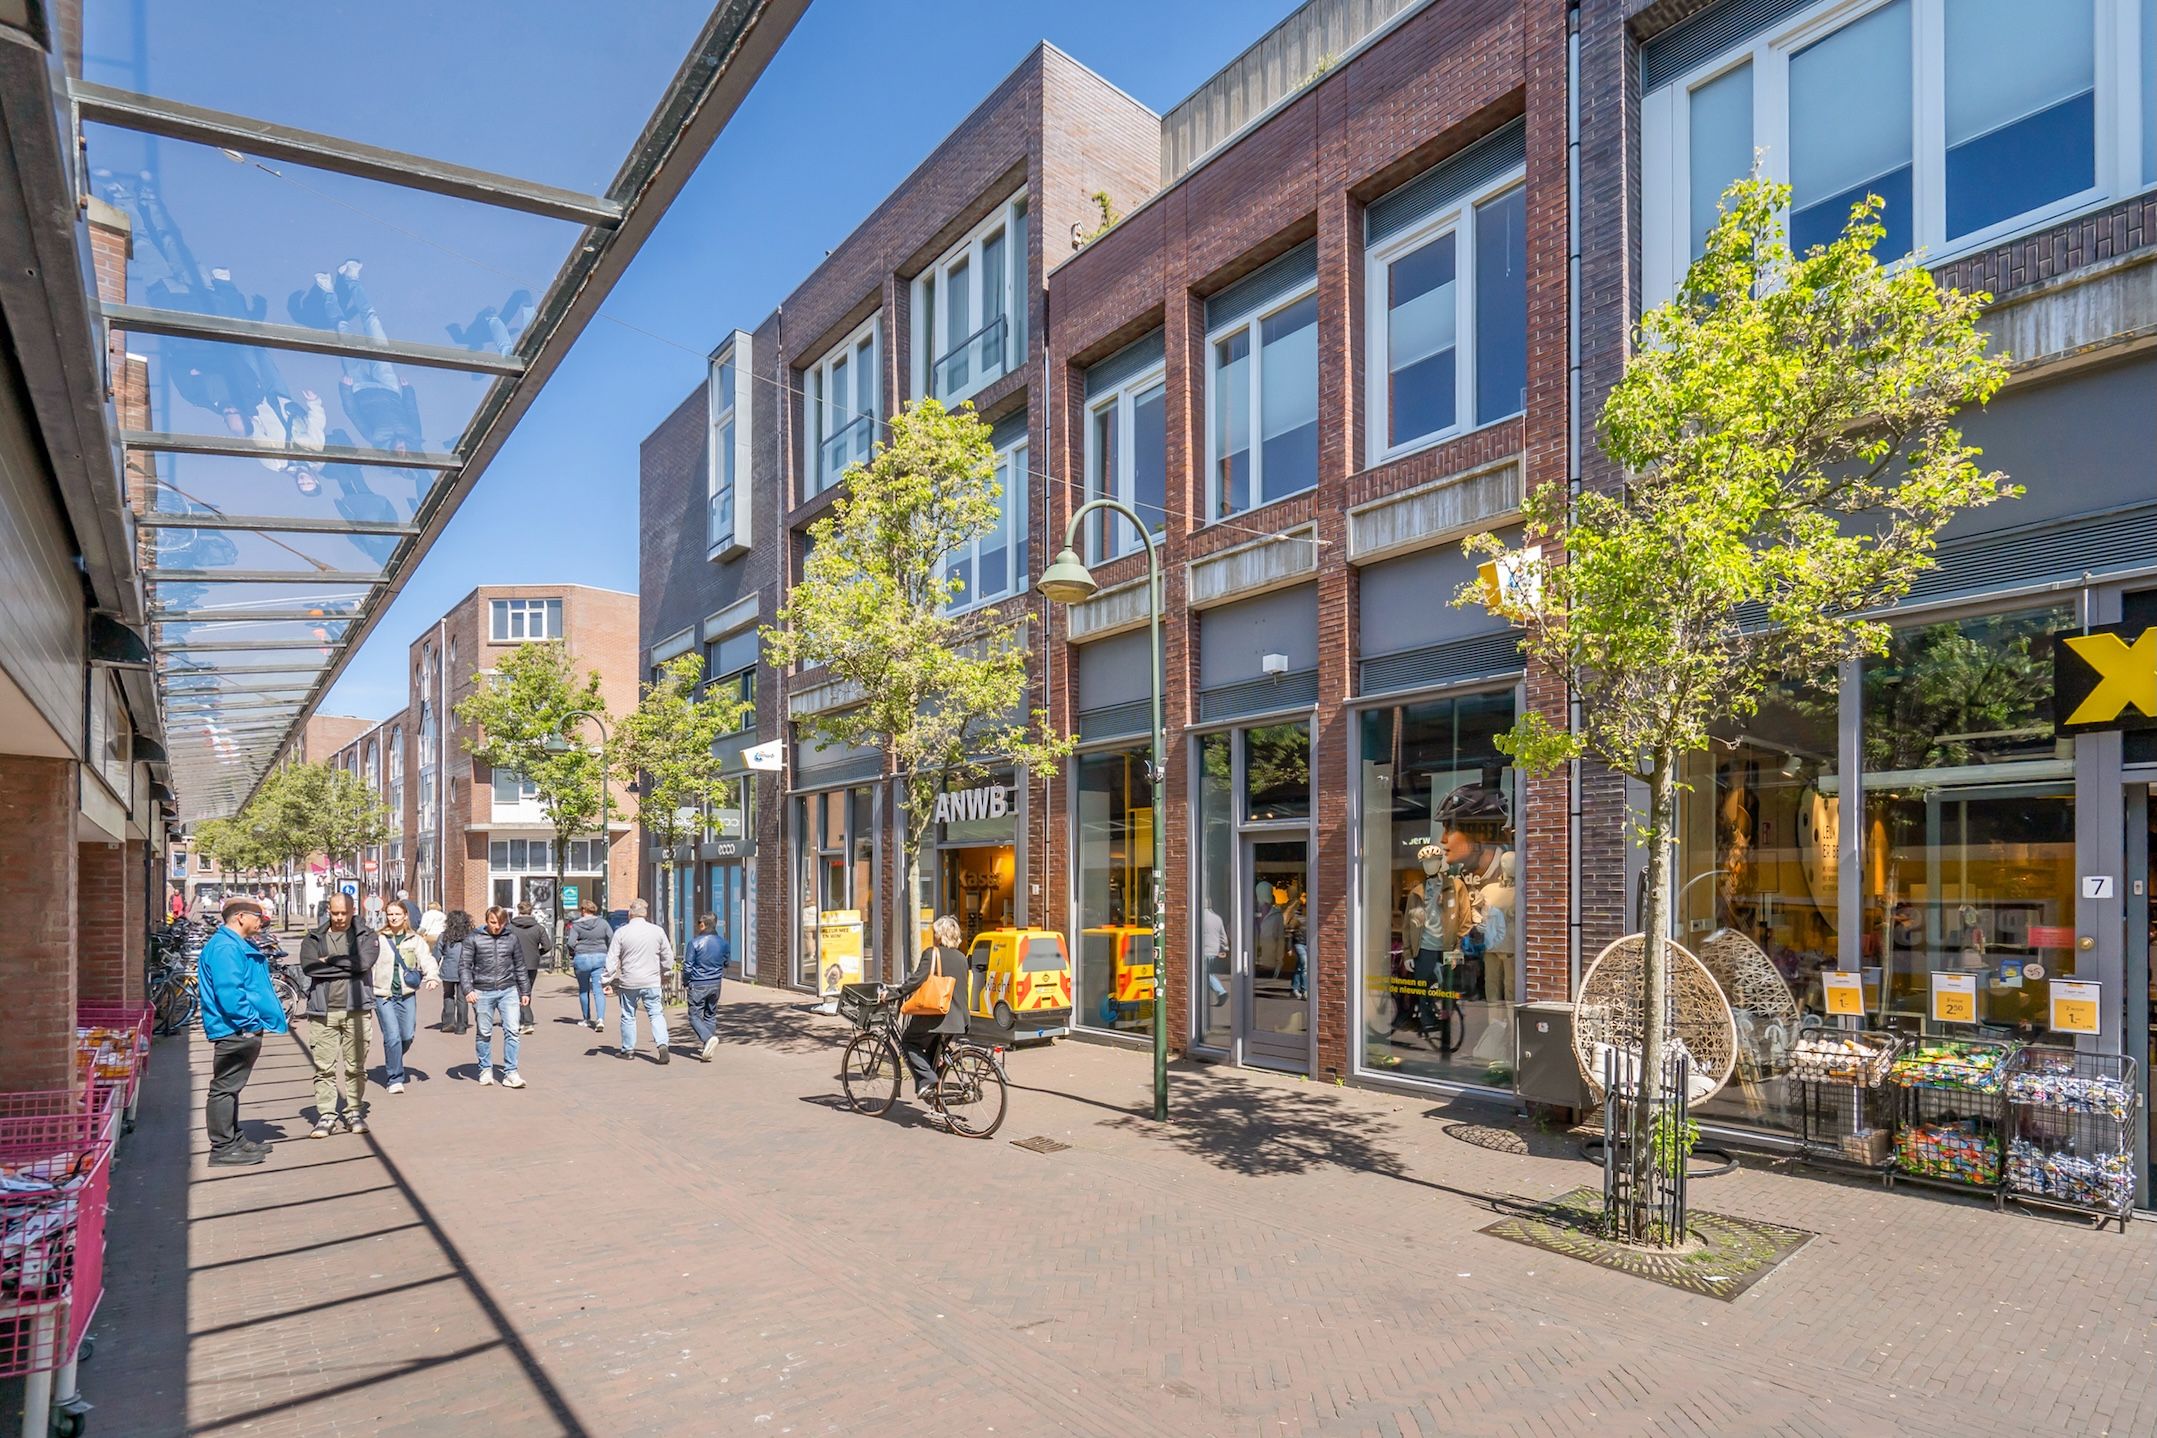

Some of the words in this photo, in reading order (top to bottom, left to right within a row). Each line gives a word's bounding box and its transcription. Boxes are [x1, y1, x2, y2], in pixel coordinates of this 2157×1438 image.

[934, 786, 1008, 824] ANWB
[2091, 879, 2105, 895] 7
[1391, 976, 1417, 986] binnen
[1417, 979, 1427, 987] en
[1389, 985, 1398, 993] de
[1400, 985, 1427, 995] nieuwe
[1428, 988, 1461, 1000] collectie
